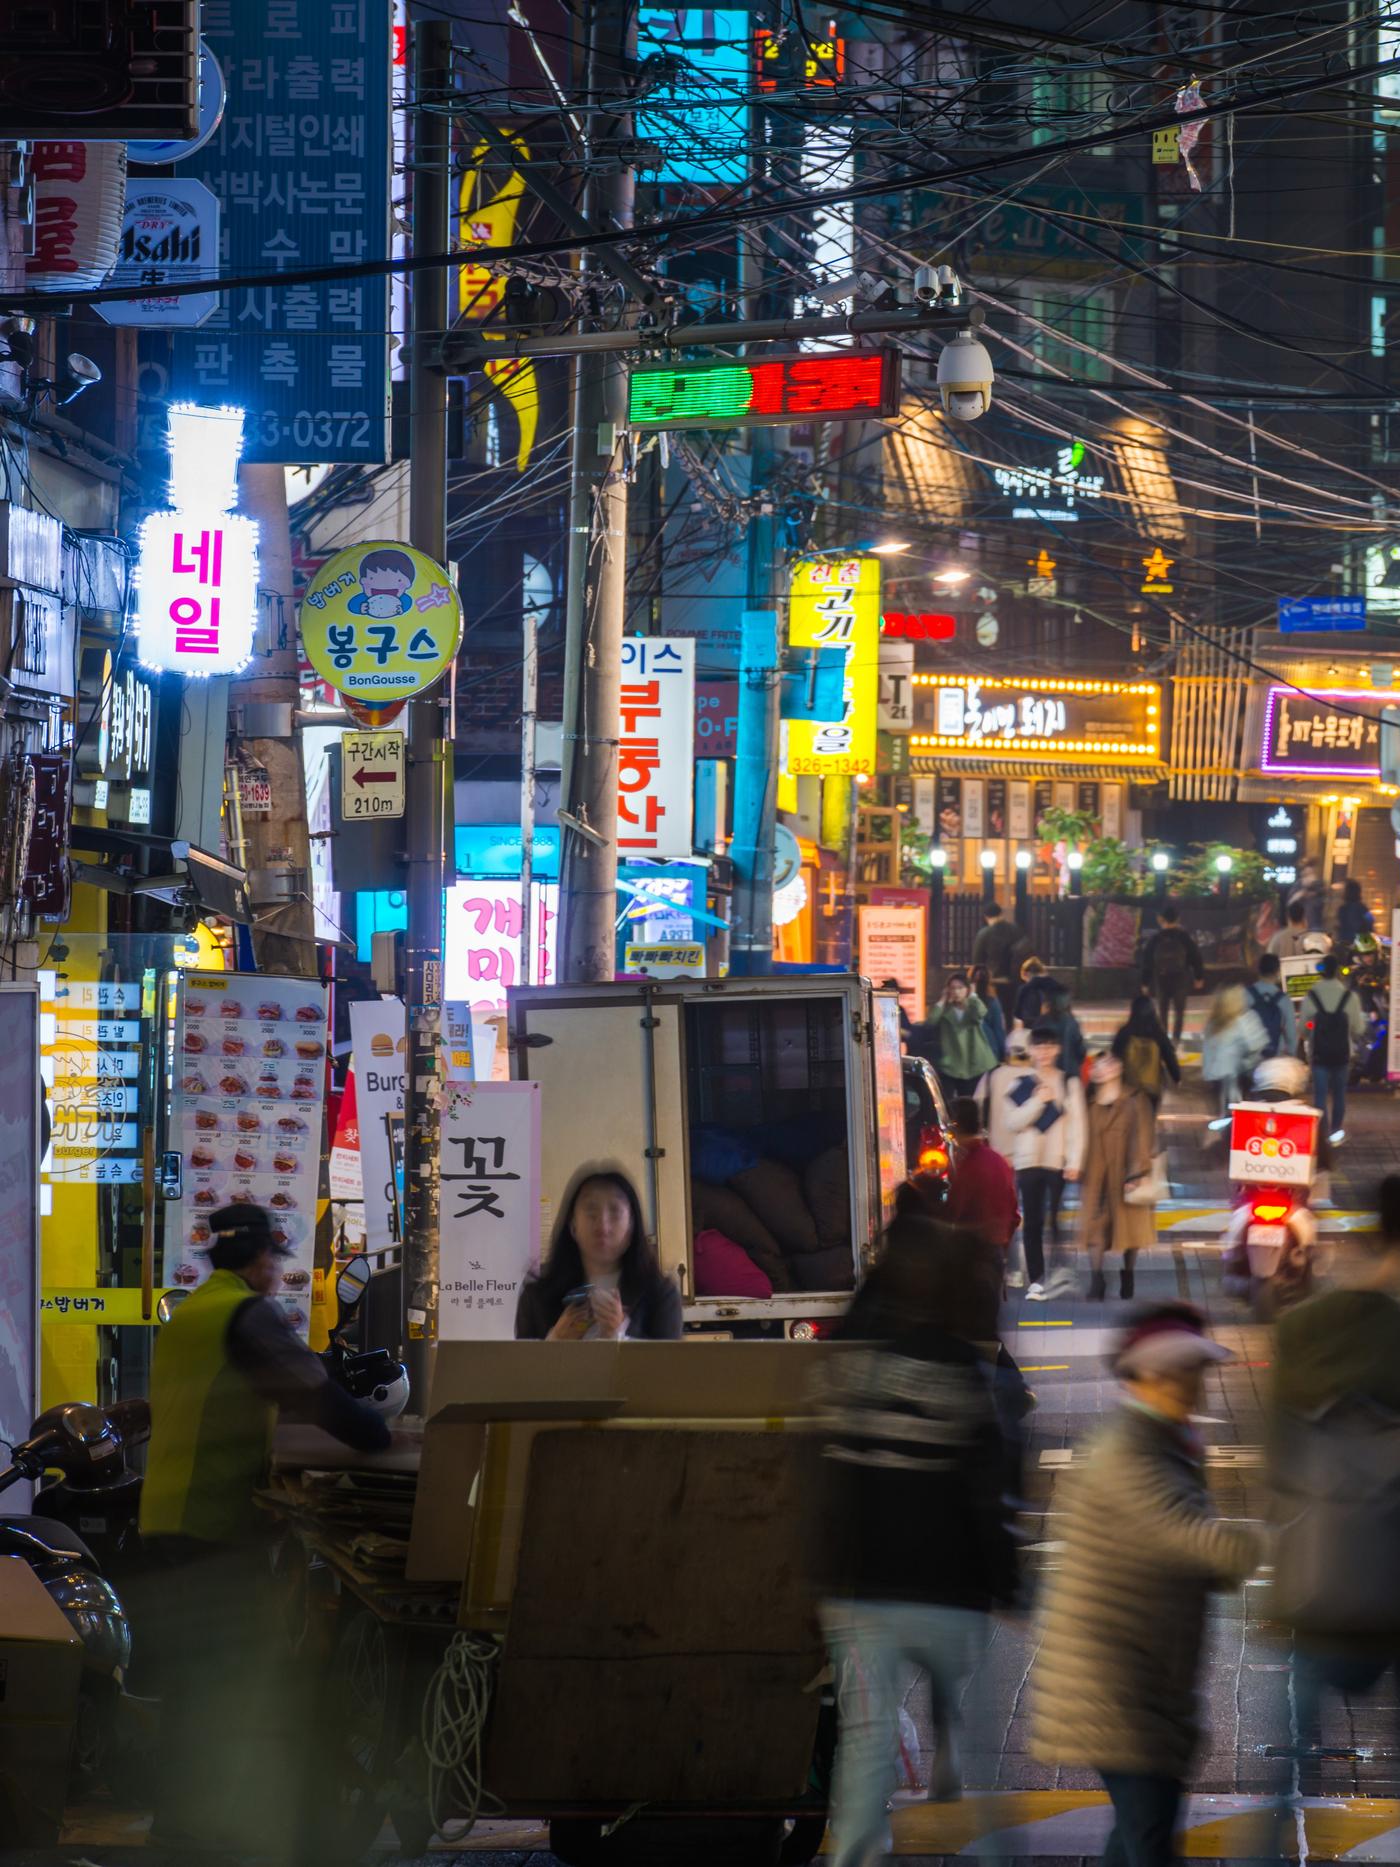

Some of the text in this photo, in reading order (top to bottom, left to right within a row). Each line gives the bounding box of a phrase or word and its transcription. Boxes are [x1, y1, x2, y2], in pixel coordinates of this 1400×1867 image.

[119, 224, 200, 263] Asahi
[810, 561, 861, 583] 신촌
[168, 529, 223, 654] 네일
[306, 570, 355, 610] 밥버거
[326, 623, 441, 669] 봉구스
[348, 674, 416, 686] BonGousse
[346, 740, 401, 763] 구간시작
[792, 757, 870, 774] 326-1342
[353, 796, 394, 815] 210m
[490, 835, 521, 846] SINCE
[439, 1135, 521, 1219] 꽃
[456, 1280, 483, 1293] Belle
[486, 1279, 517, 1293] Fleur
[55, 1295, 105, 1312] 밥버거
